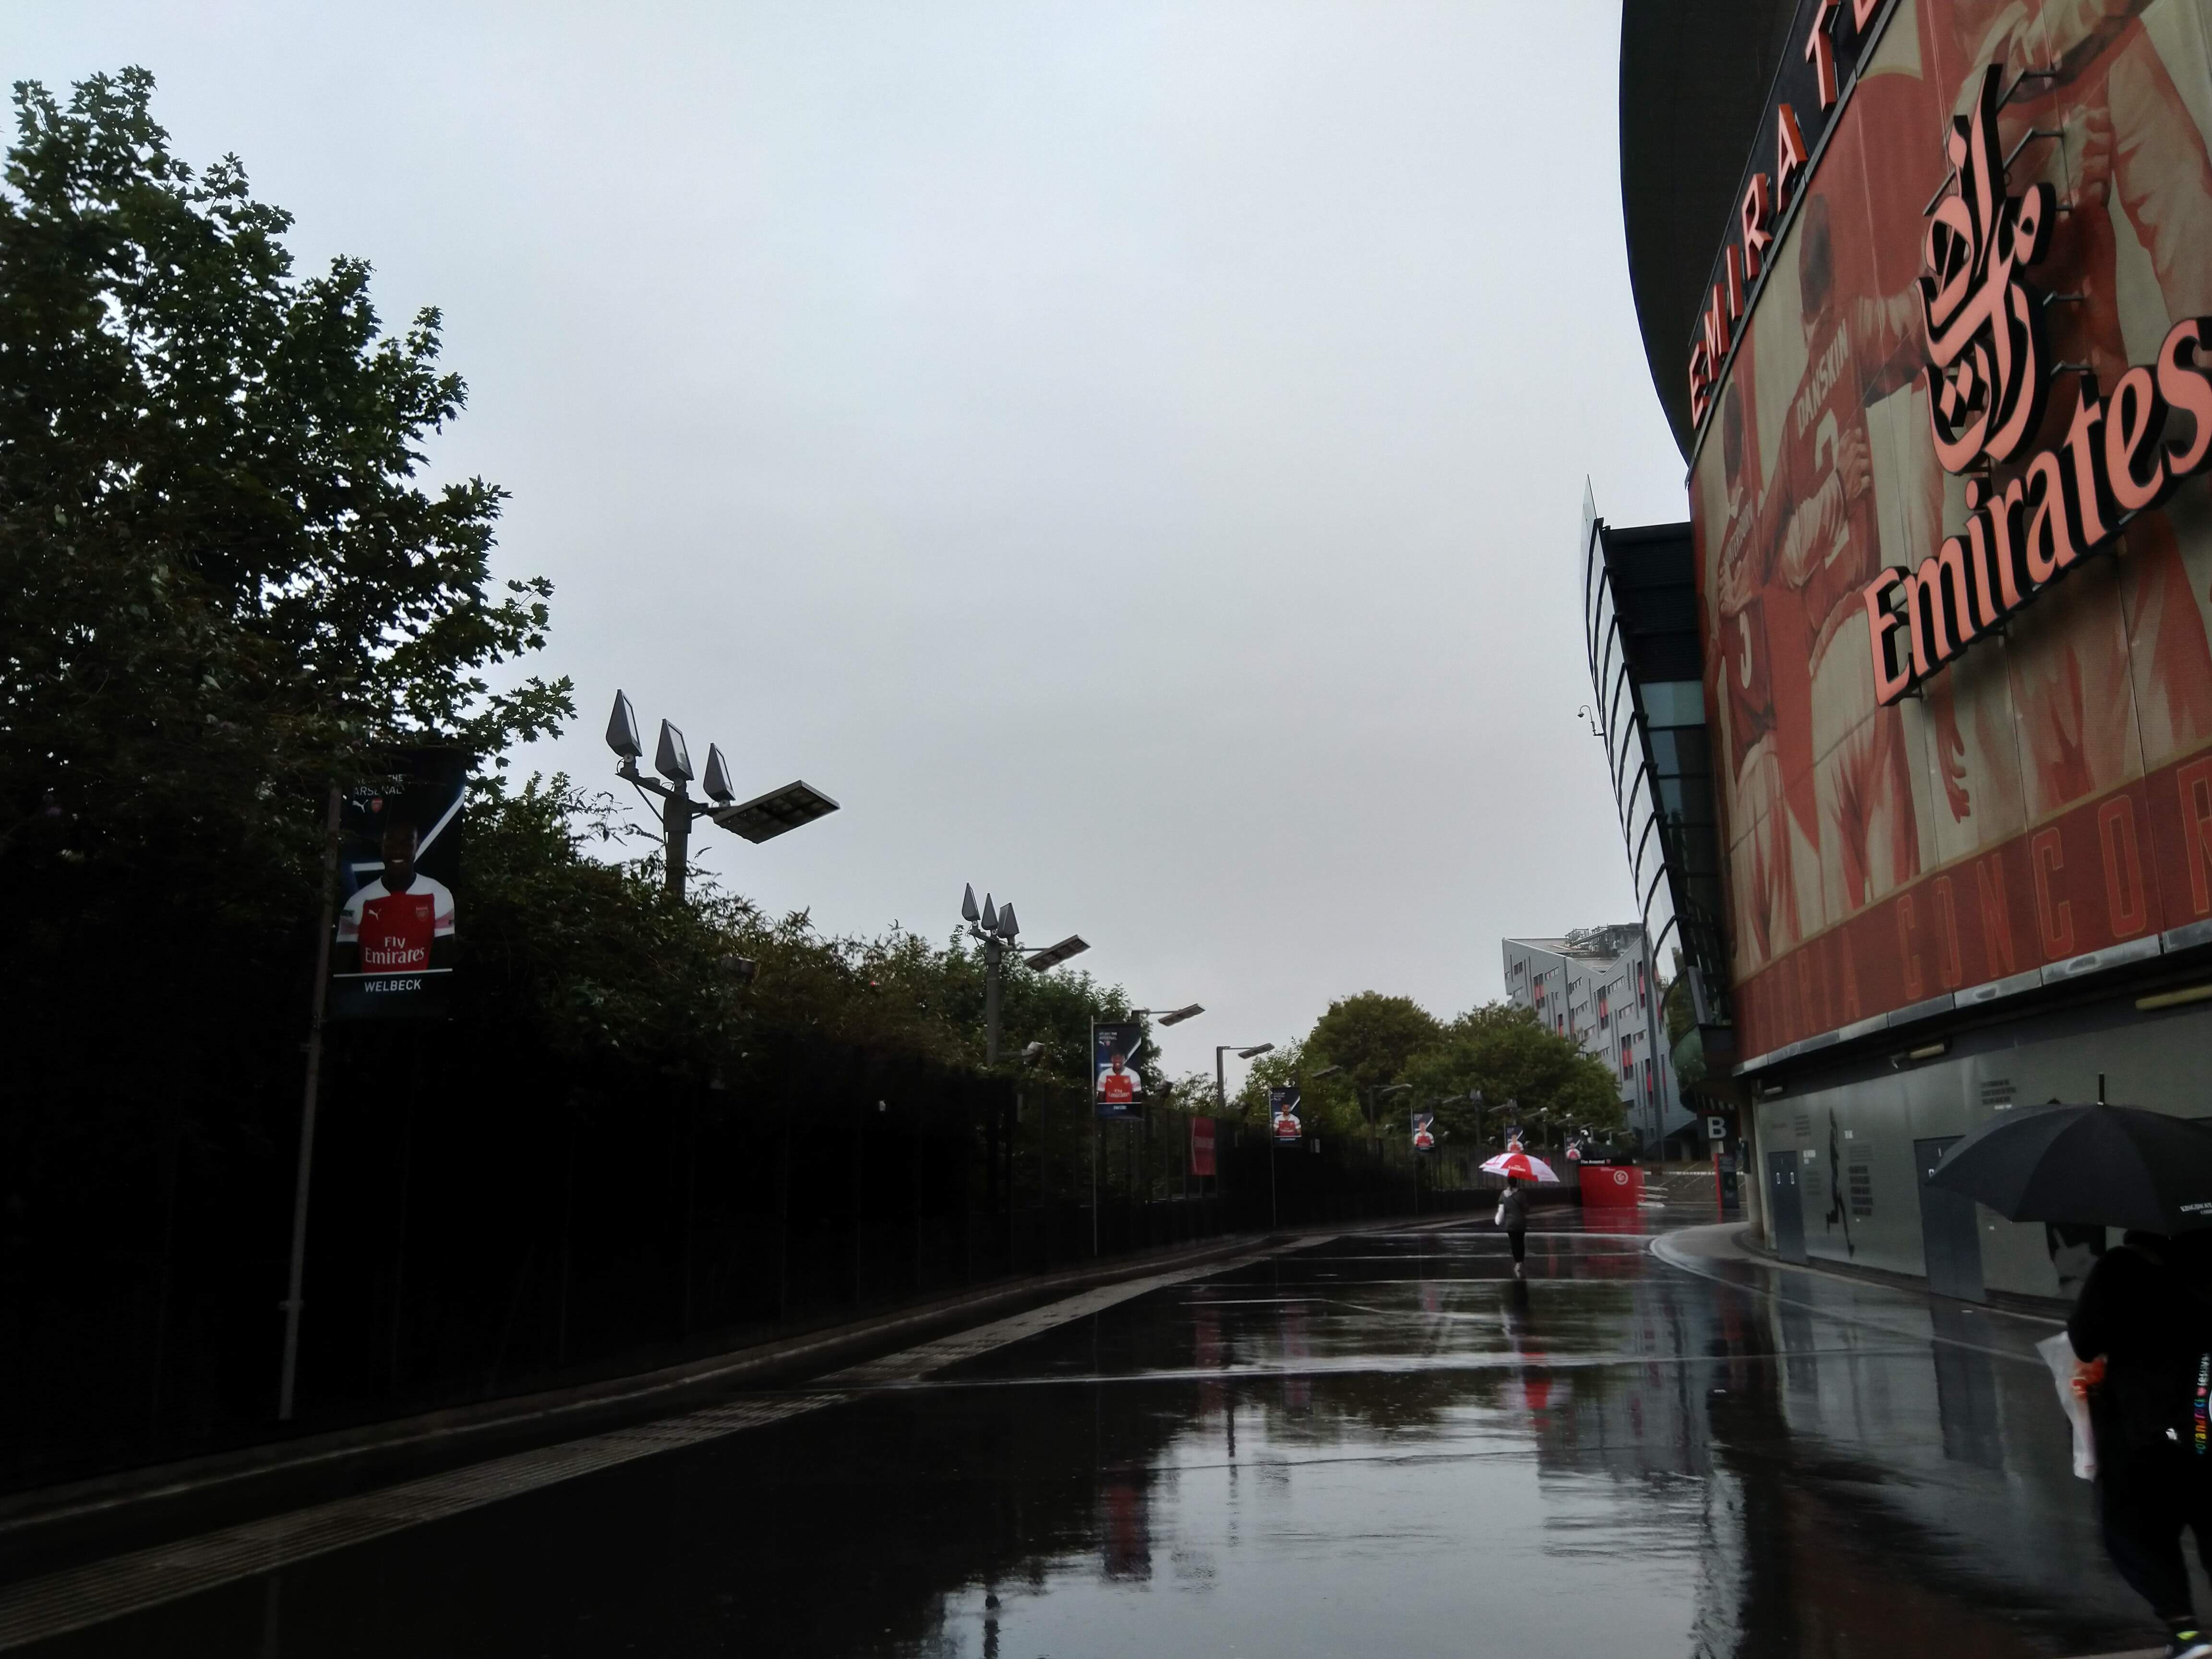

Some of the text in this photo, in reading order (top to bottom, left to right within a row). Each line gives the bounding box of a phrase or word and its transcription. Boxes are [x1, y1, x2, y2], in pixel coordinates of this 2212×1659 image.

[1688, 0, 1877, 430] EMIRAT
[1796, 318, 1850, 440] DANSKIN
[1863, 317, 2212, 706] Emirates
[385, 936, 406, 949] Fly
[365, 947, 425, 964] Emirates
[364, 979, 422, 993] WELBECK
[1707, 1116, 1727, 1139] B
